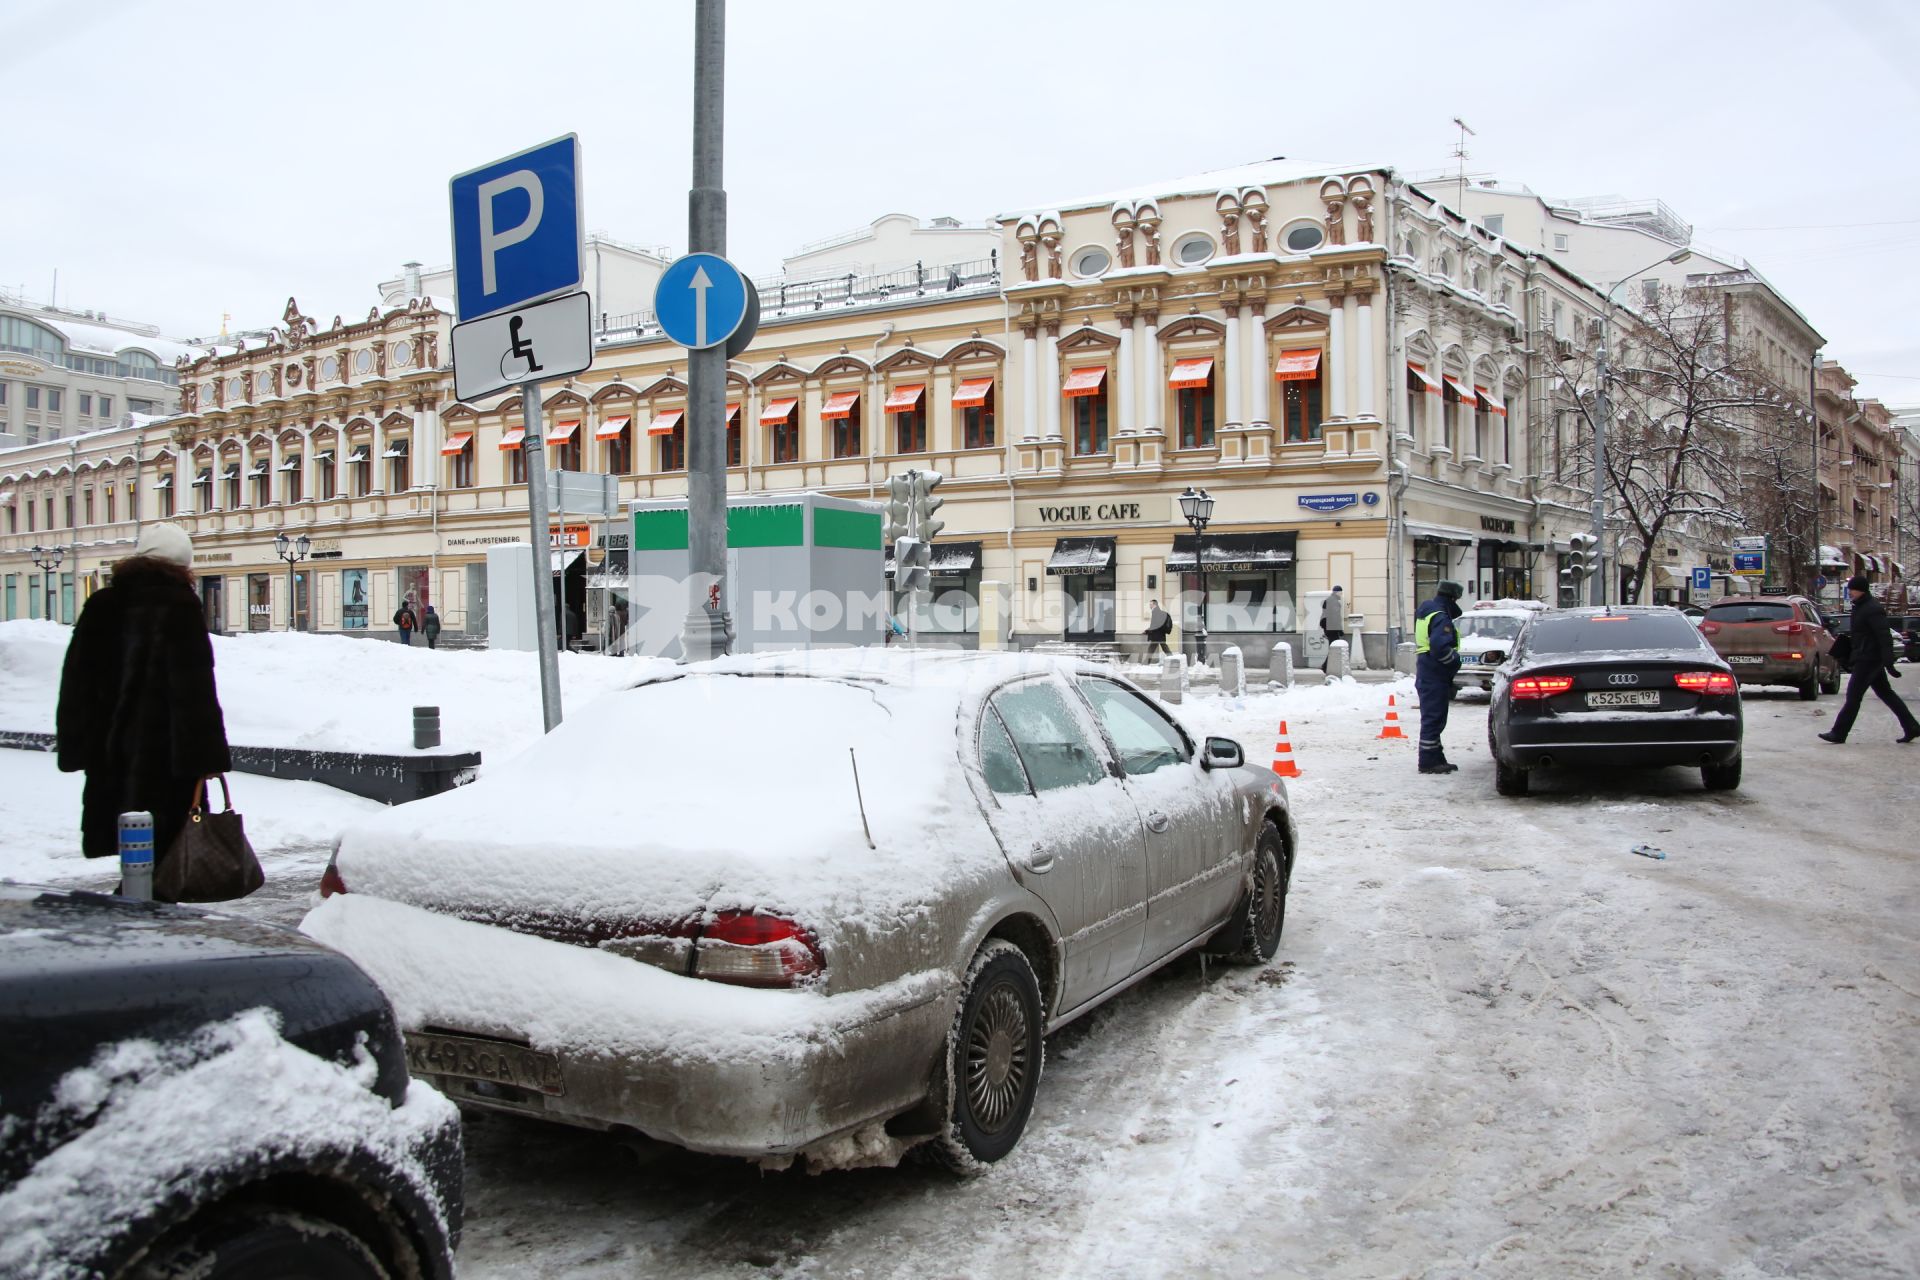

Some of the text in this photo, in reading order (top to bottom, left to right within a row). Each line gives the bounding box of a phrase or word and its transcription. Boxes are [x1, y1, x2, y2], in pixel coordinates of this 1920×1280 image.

[478, 169, 544, 297] P
[1301, 496, 1335, 505] Кузнецкий
[1367, 494, 1374, 503] 7
[1038, 503, 1141, 523] VOGUE CAFE
[447, 538, 466, 547] DIANE
[475, 535, 521, 545] FURSTENBERG
[1053, 566, 1100, 576] VOGUE CAFE
[1201, 562, 1252, 573] VOGUE CAFE
[1695, 570, 1707, 588] P
[250, 604, 271, 615] SALE
[1591, 691, 1657, 705] К525ХЕ 197
